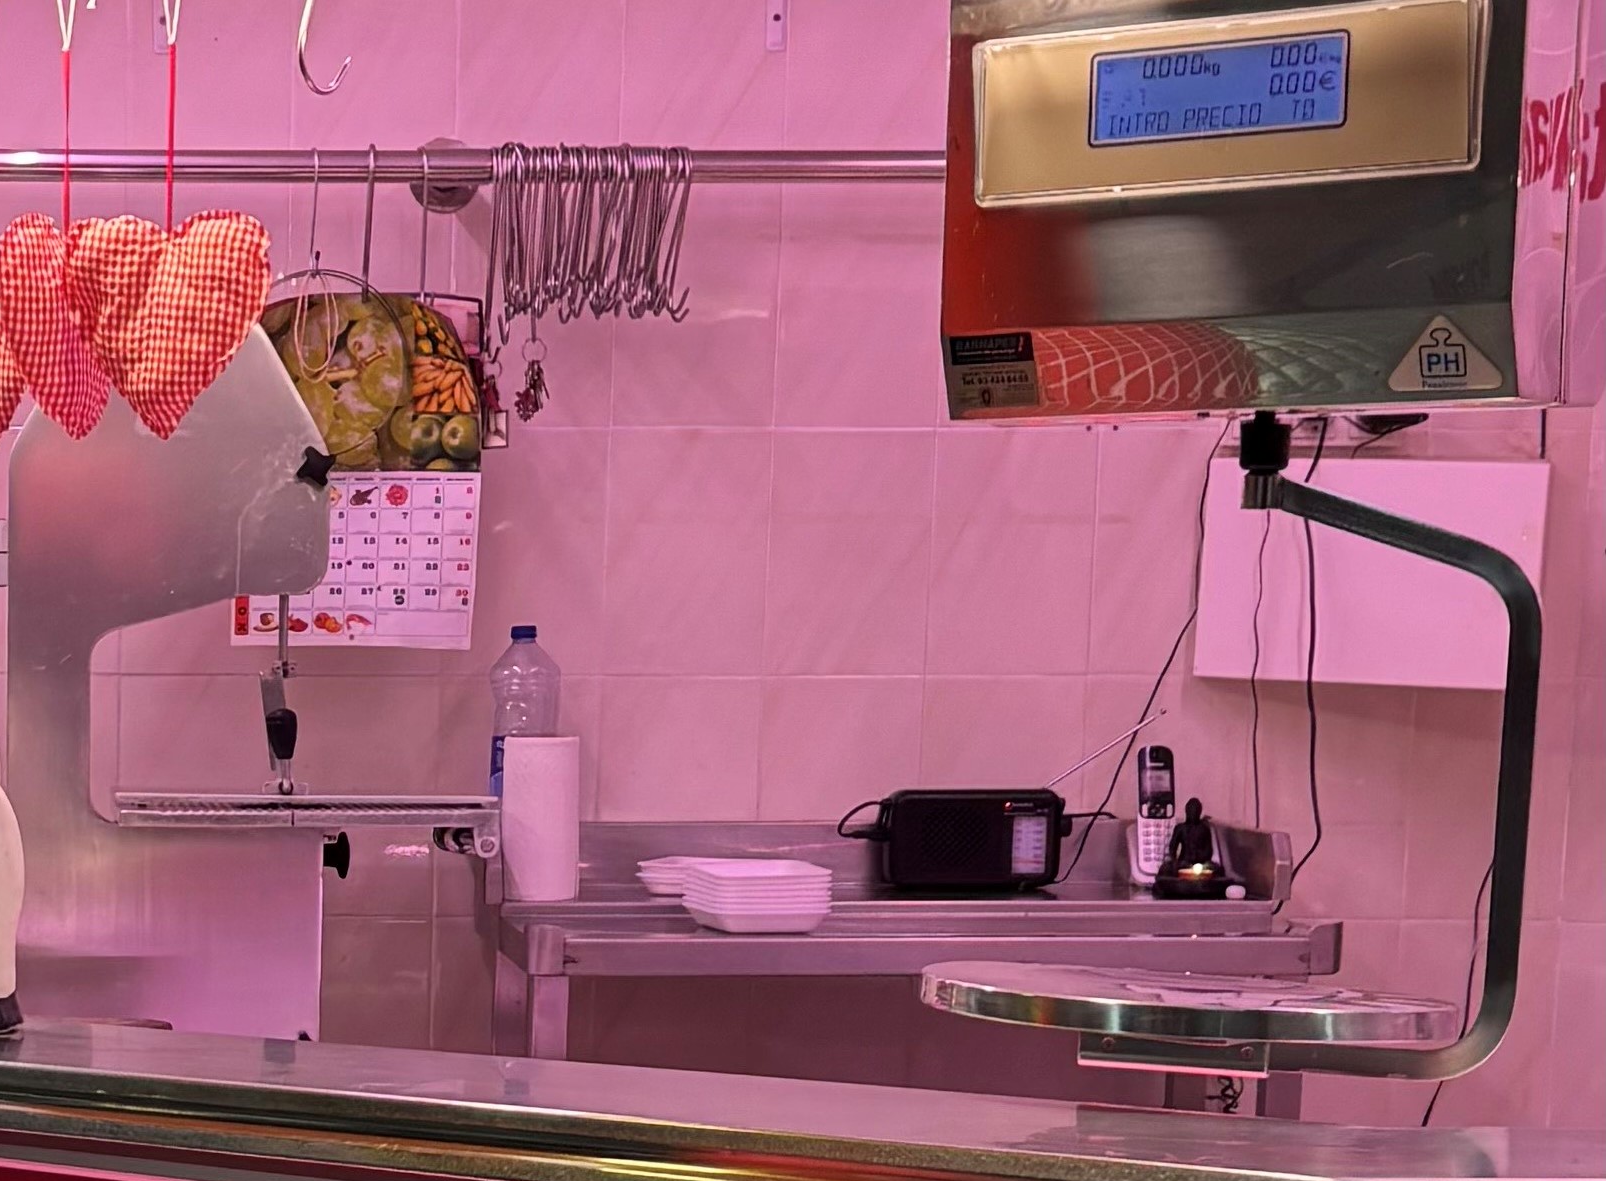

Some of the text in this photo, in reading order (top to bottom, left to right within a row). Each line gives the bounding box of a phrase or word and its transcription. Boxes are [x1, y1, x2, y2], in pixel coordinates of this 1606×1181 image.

[1108, 110, 1170, 136] INTRO
[1182, 102, 1262, 130] PRECIO
[1426, 352, 1461, 374] PH
